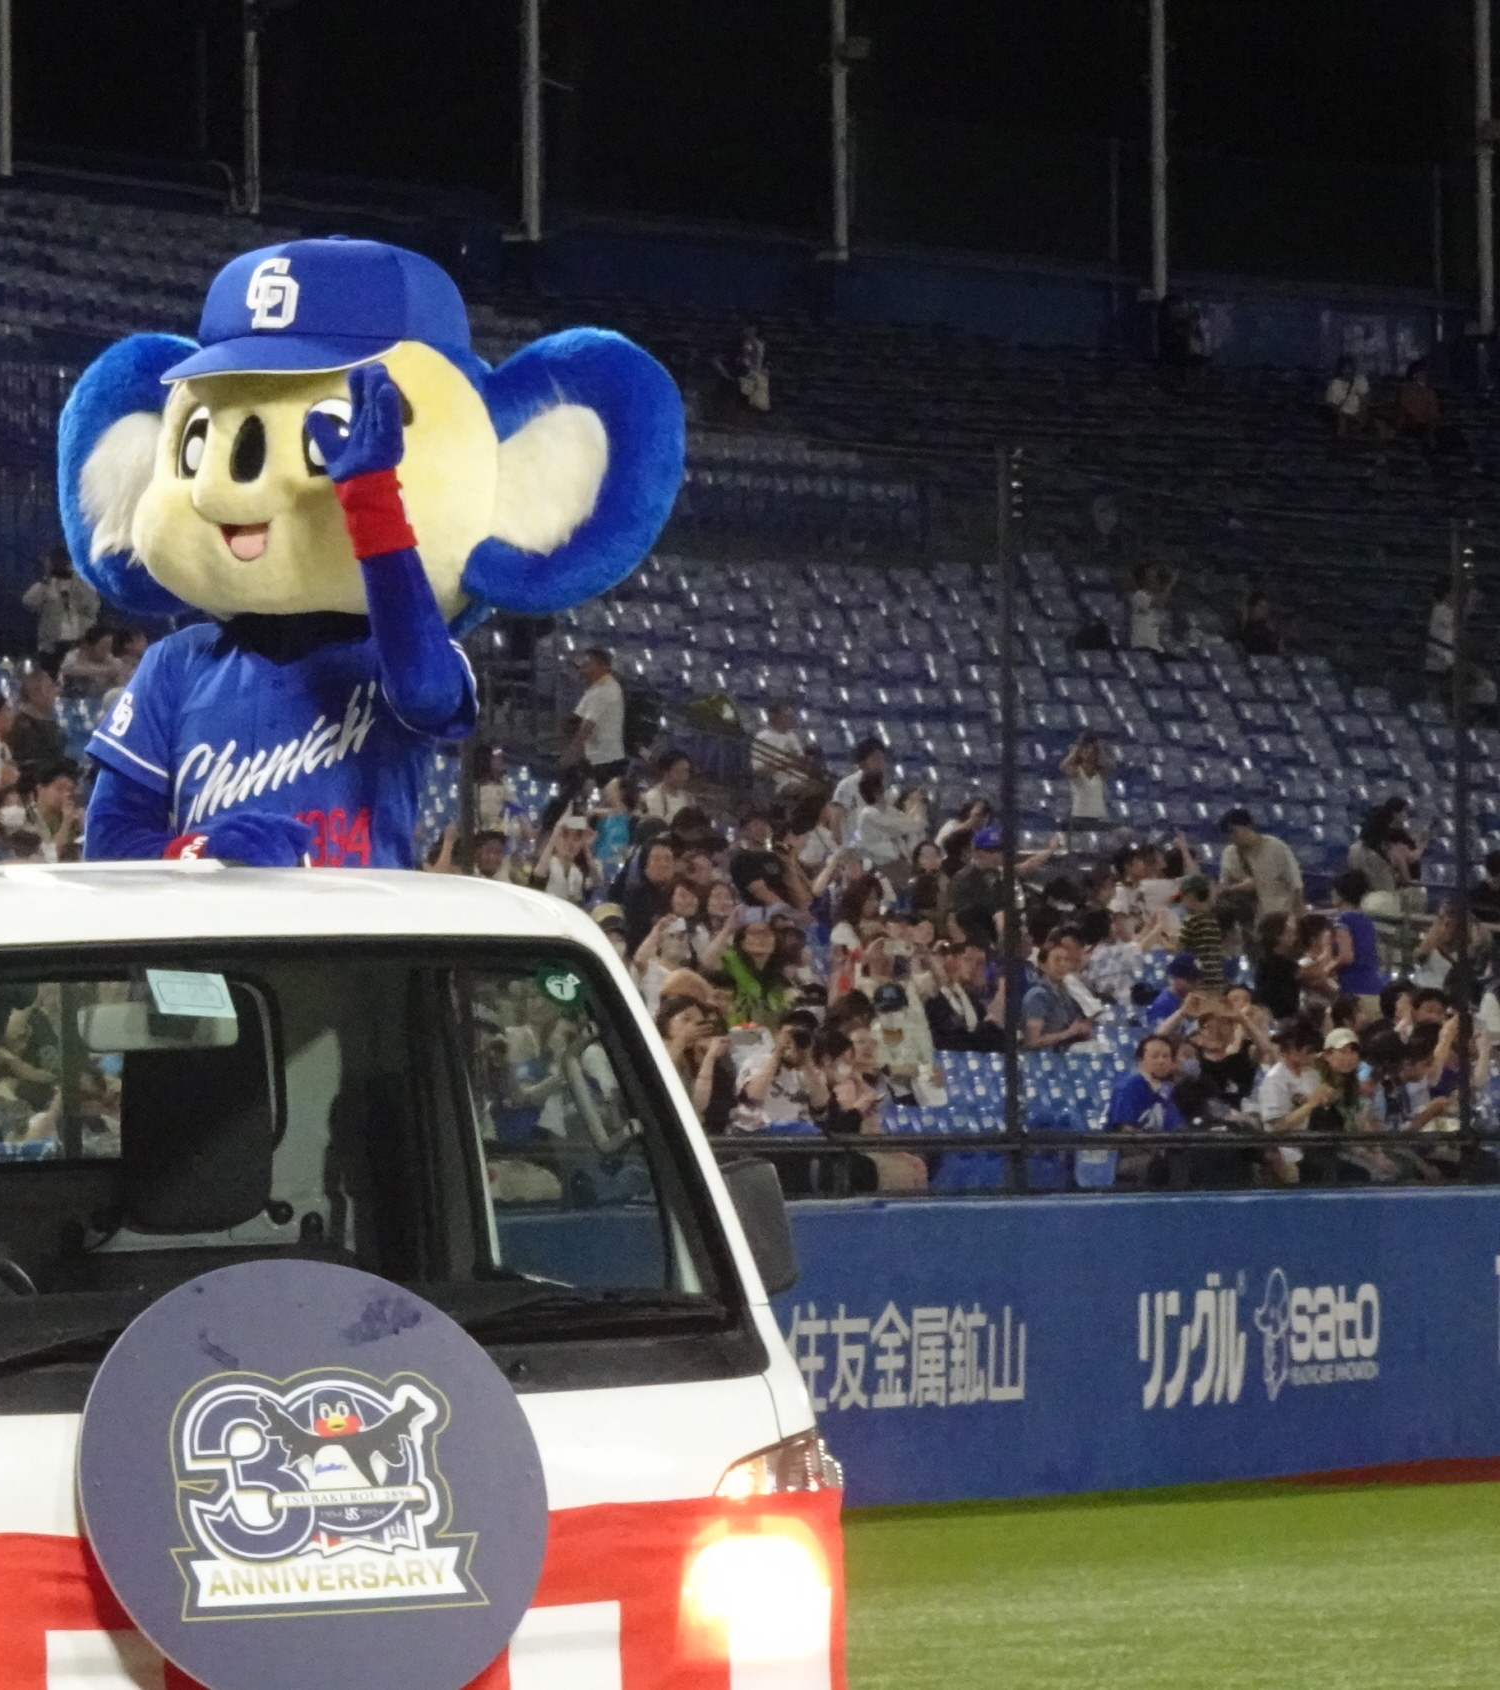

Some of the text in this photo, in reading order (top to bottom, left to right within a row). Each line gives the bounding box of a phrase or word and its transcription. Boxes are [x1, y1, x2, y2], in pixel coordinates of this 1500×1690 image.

[168, 680, 376, 836] Chunichi
[787, 1301, 1026, 1412] 住友金属鉱山
[1138, 1272, 1247, 1411] リングル
[283, 1488, 381, 1506] TSUBAKUROU
[390, 1521, 407, 1536] th
[208, 1558, 447, 1597] ANNIVERSARY
